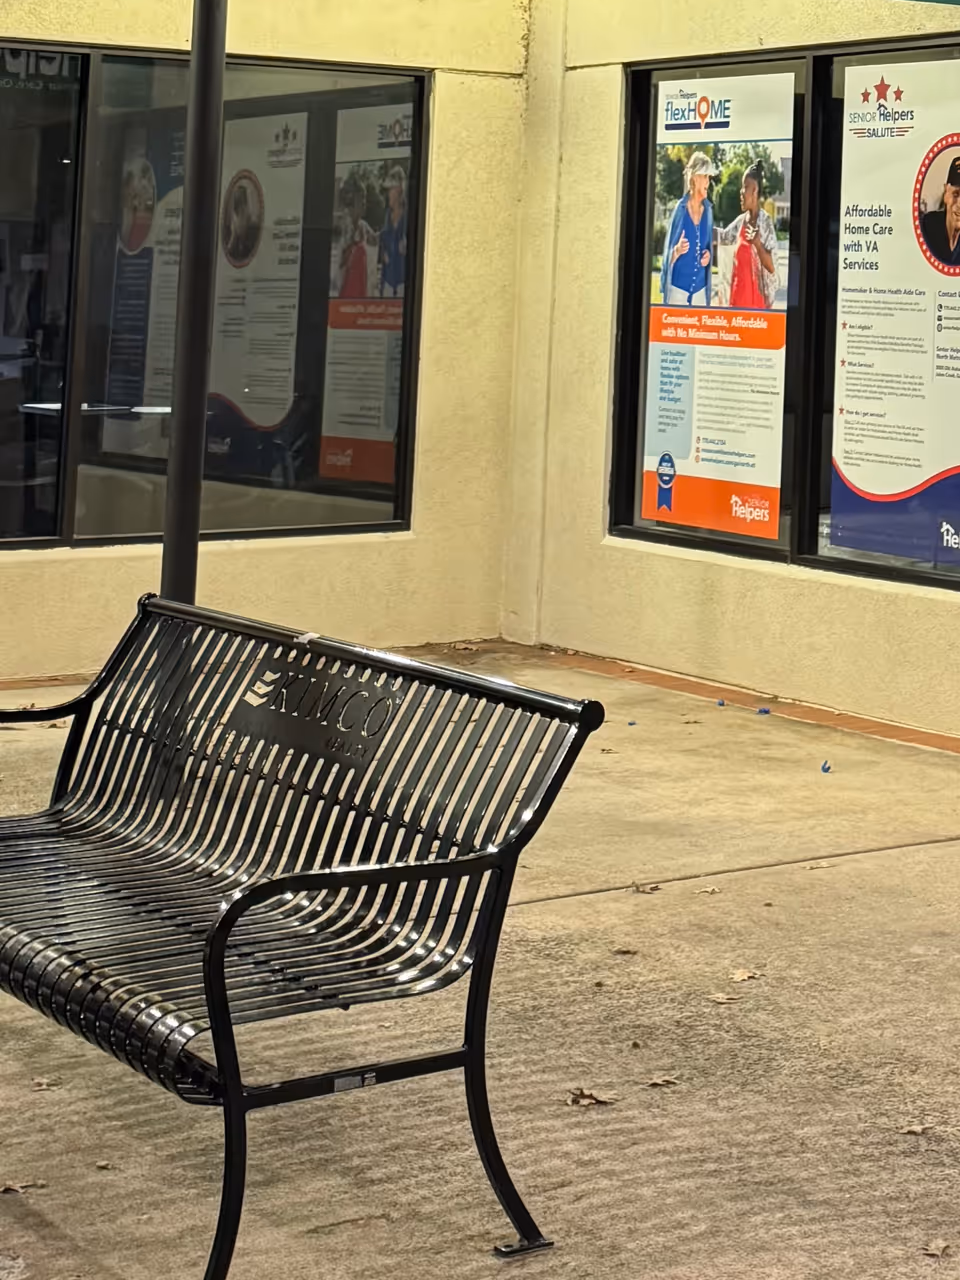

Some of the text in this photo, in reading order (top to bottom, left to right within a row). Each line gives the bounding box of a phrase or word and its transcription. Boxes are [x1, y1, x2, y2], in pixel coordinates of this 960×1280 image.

[665, 96, 731, 121] flexHOME
[849, 108, 914, 124] SENIOR Helpers
[867, 127, 895, 138] SALUTE
[845, 204, 892, 217] Affordable
[844, 223, 893, 235] Home Care
[844, 240, 879, 252] with VA
[843, 258, 879, 270] Services
[731, 317, 768, 329] Affordable
[661, 328, 676, 337] with
[748, 499, 769, 509] SENIOR
[732, 501, 769, 522] Helpers
